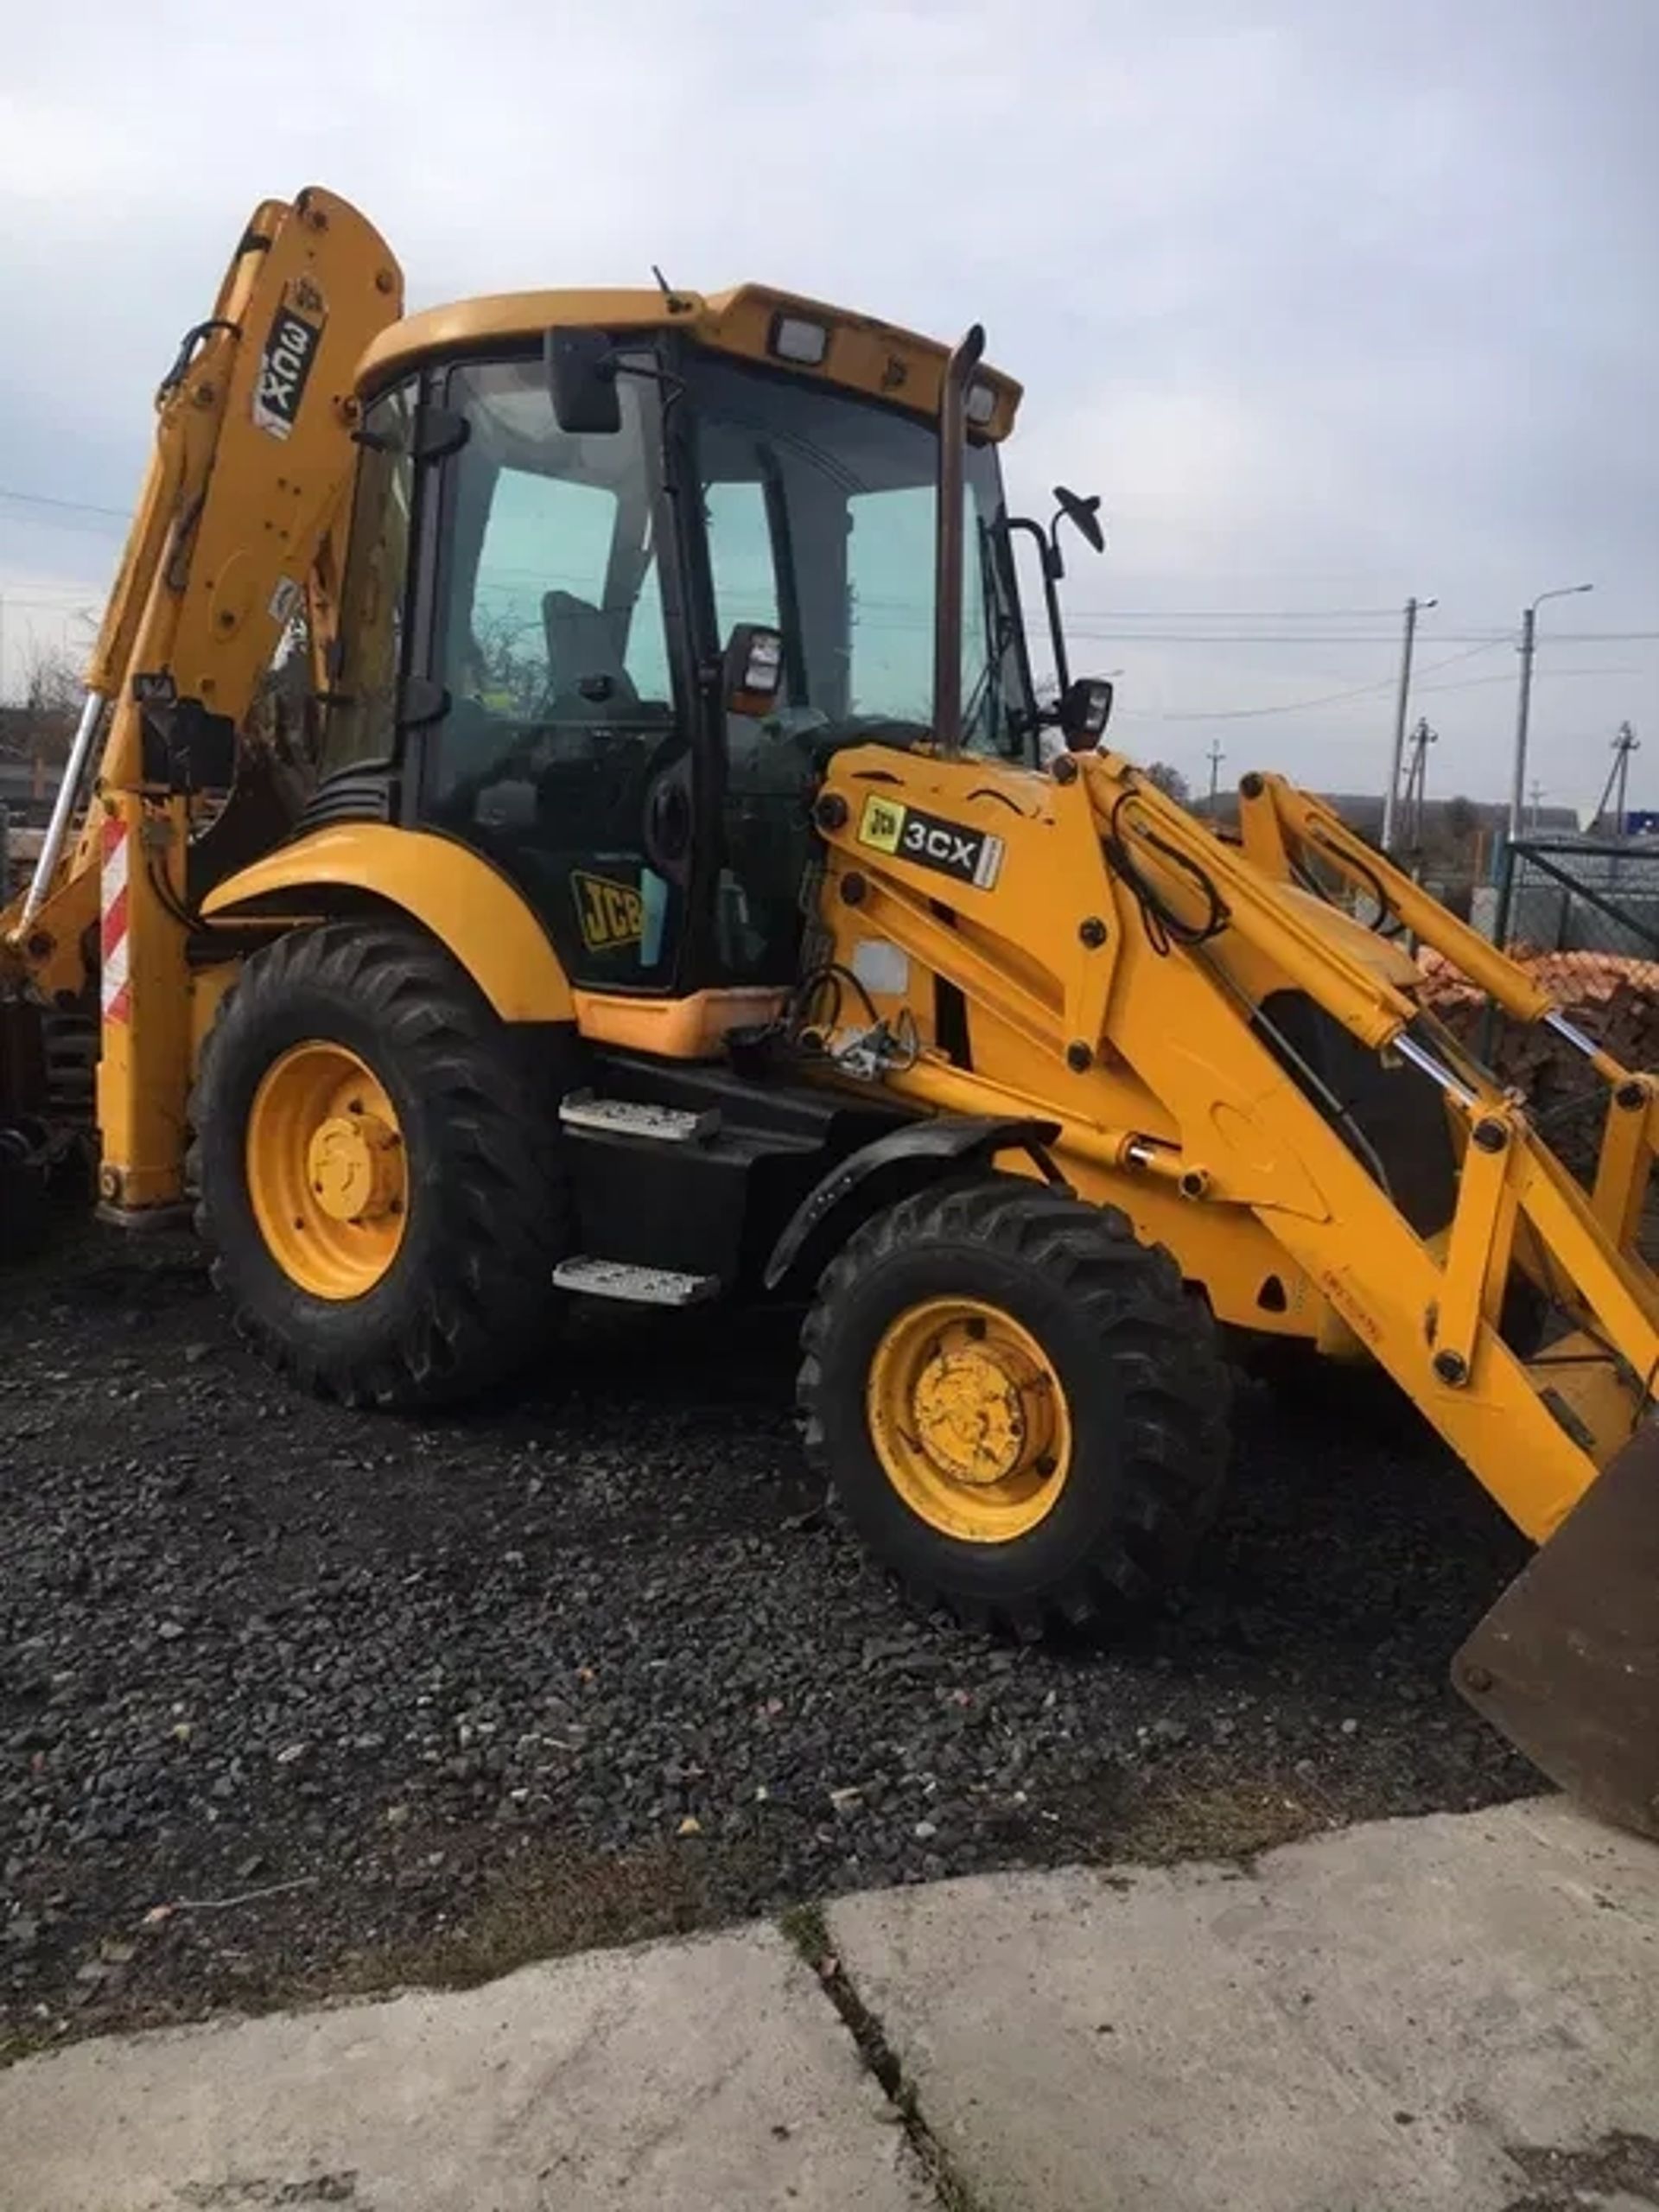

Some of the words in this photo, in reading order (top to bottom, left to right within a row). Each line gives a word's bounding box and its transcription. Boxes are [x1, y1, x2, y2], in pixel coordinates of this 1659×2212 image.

[263, 321, 308, 410] 3CX
[904, 823, 978, 868] 3CX
[583, 880, 643, 943] JCB
